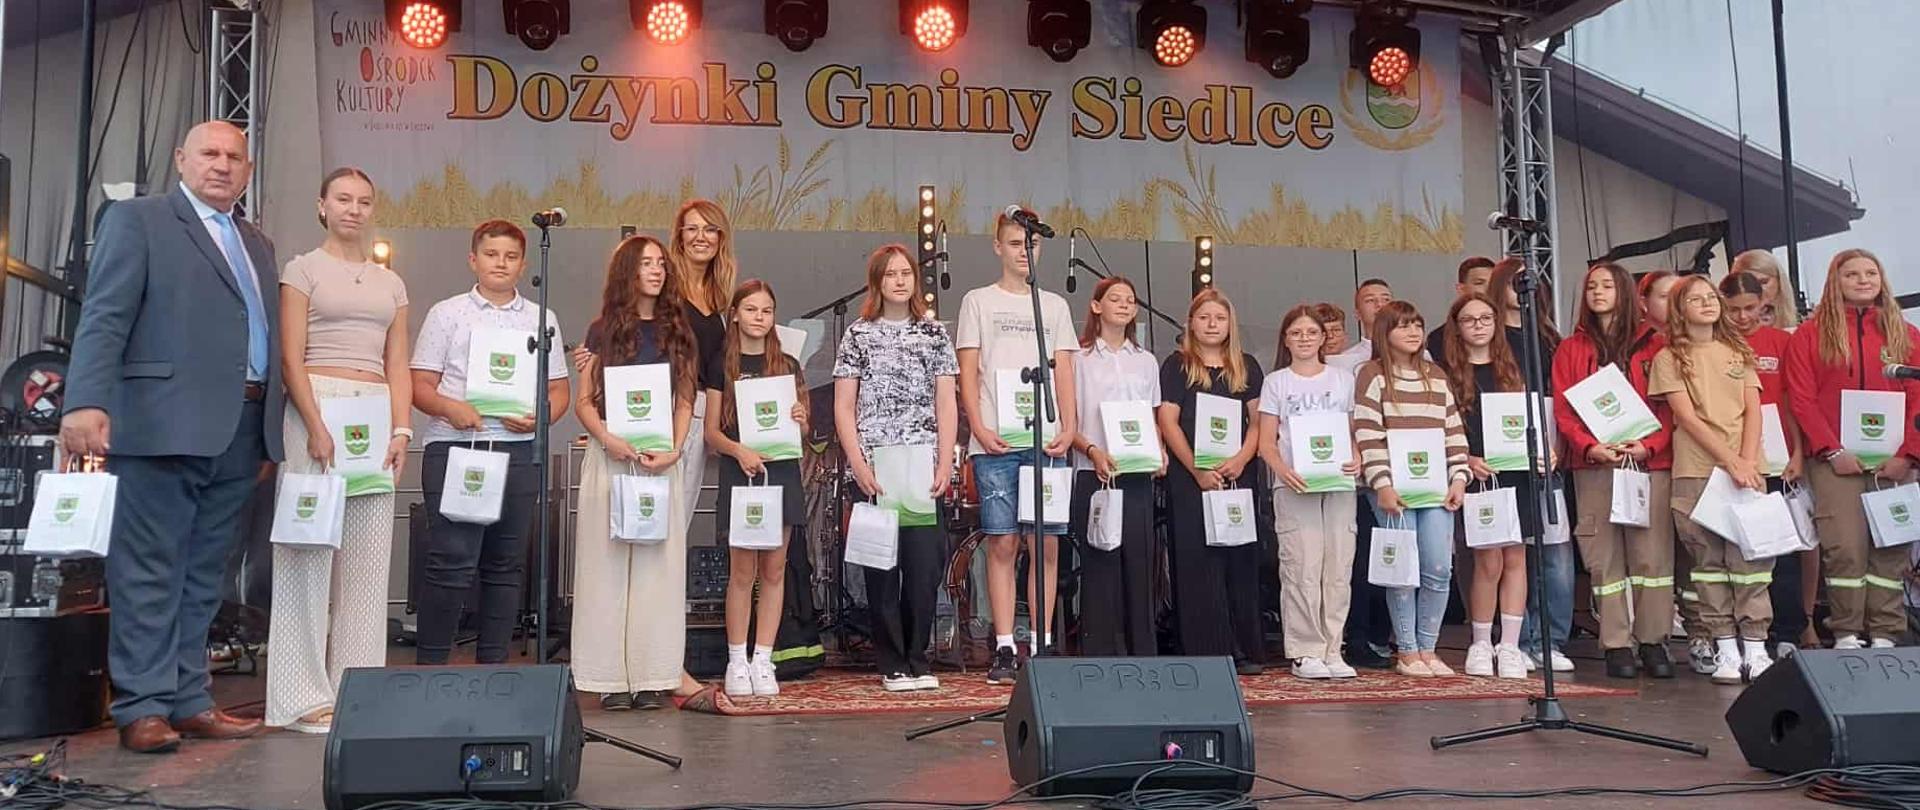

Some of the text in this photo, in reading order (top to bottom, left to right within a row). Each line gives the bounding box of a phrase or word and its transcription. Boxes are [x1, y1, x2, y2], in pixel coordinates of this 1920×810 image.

[360, 46, 436, 84] OŚRODEK
[336, 79, 405, 114] KULTURY
[446, 54, 1334, 151] Dożynki Gminy Siedlce
